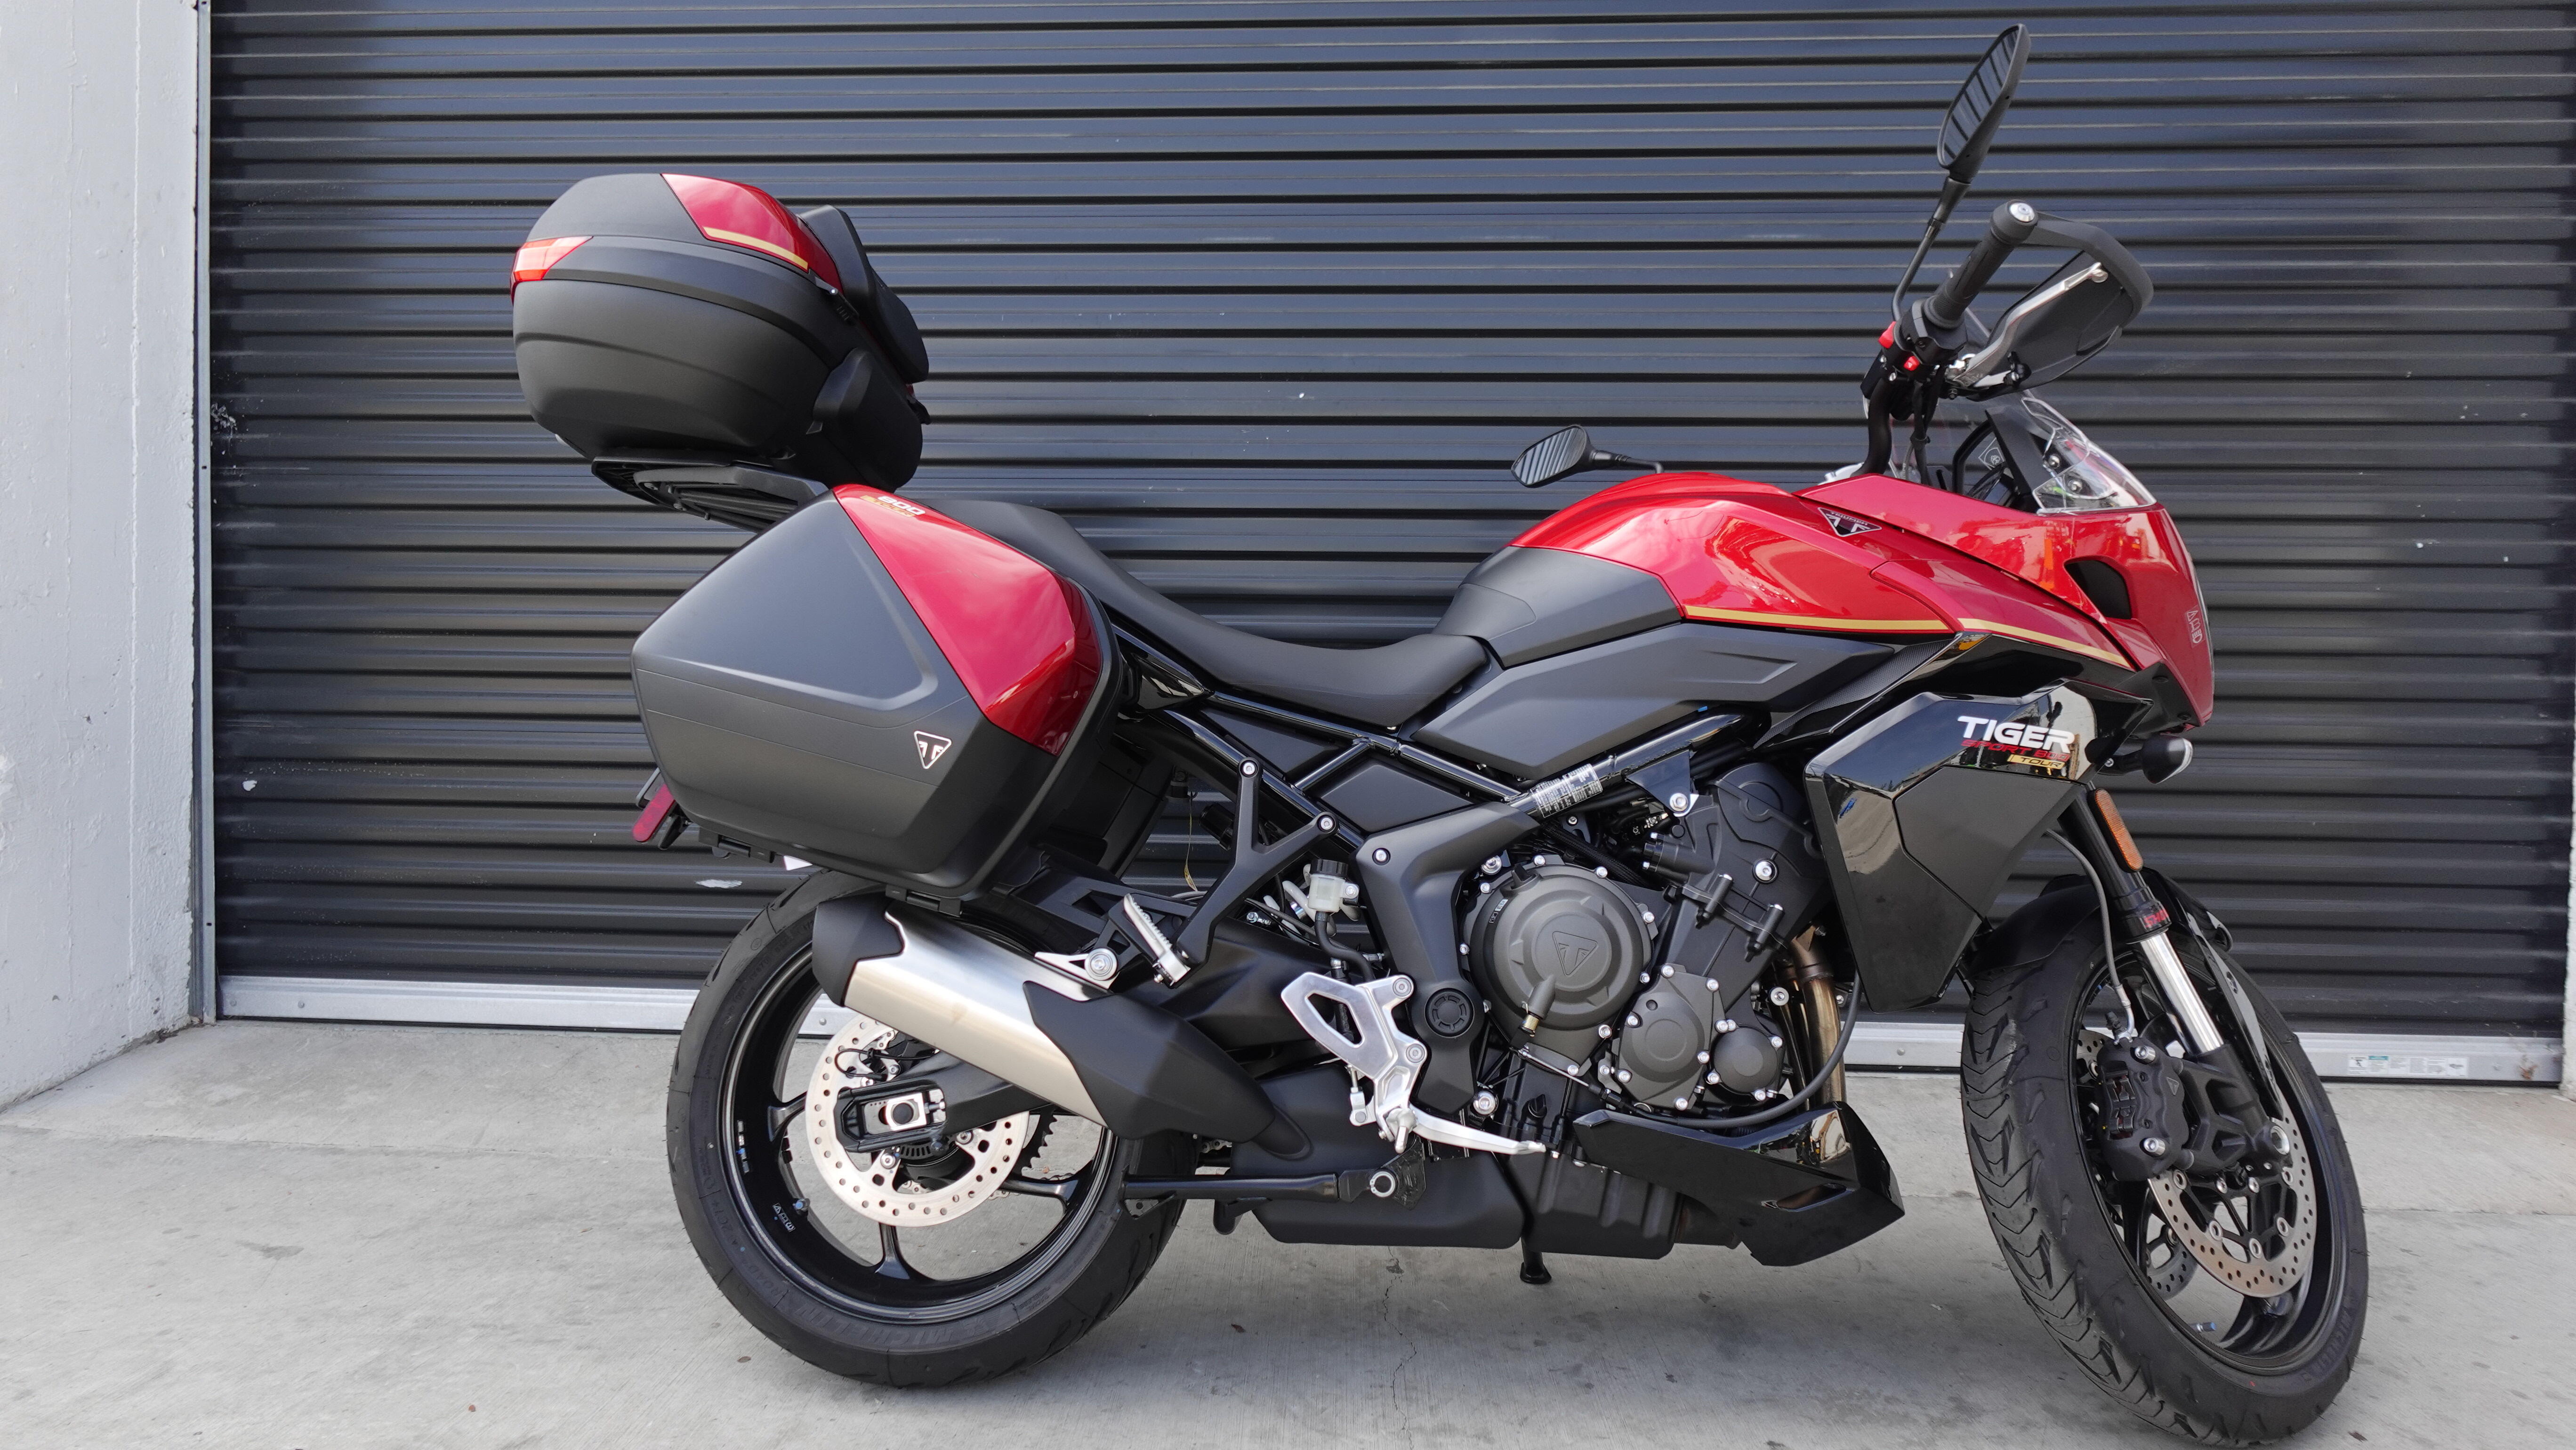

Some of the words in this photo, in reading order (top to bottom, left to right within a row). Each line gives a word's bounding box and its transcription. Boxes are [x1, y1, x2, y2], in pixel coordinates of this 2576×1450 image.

[877, 496, 926, 515] 800
[1957, 716, 2075, 753] TIGER
[1961, 739, 2032, 755] SPORT
[2033, 749, 2071, 761] 800
[2020, 757, 2062, 767] TOUR
[795, 1307, 953, 1345] MICHELIN
